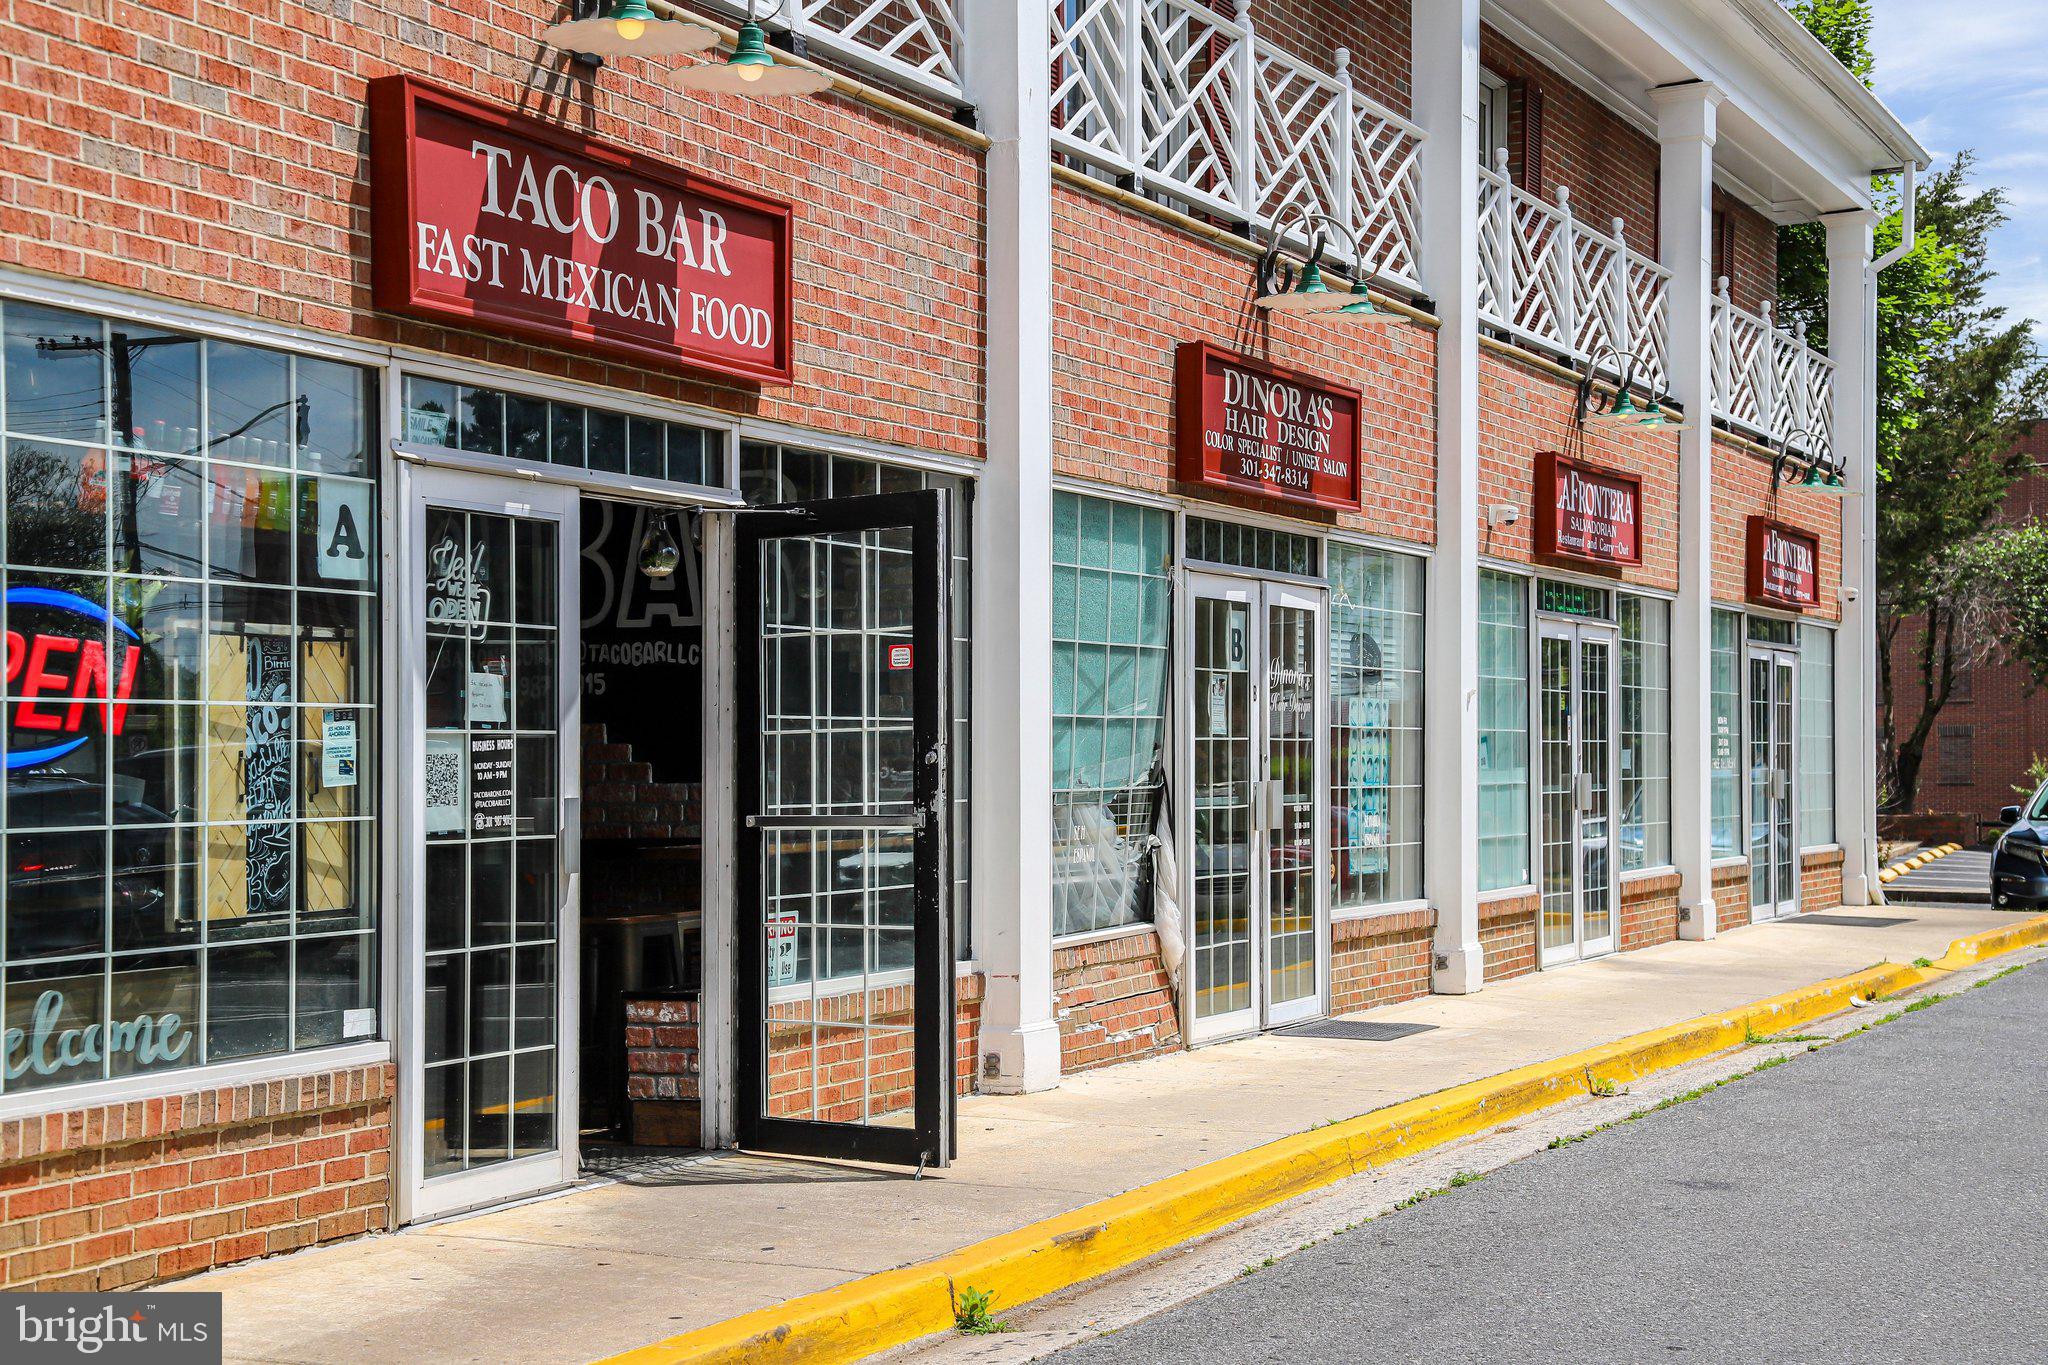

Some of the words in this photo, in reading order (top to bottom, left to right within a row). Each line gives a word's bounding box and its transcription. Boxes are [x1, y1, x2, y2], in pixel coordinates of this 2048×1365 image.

[472, 139, 619, 244] TACO
[634, 188, 731, 277] BAR
[417, 221, 508, 288] FAST
[520, 247, 680, 330] MEXICAN
[690, 292, 772, 349] FOOD
[1223, 368, 1333, 431] DINORA'S
[1205, 430, 1234, 452] COLOR
[1238, 437, 1282, 463] SPECIALIST
[1292, 451, 1320, 472] UNISEX
[1323, 458, 1347, 477] SALON
[1226, 408, 1268, 439] HAIR
[1277, 421, 1330, 454] DESIGN
[327, 504, 364, 559] A
[1557, 529, 1585, 548] Restaurant
[1587, 536, 1597, 549] and
[1600, 538, 1629, 555] Carry-Out
[1570, 516, 1617, 538] SALVADORIAN
[429, 597, 481, 629] OPEN
[1231, 628, 1243, 662] B
[472, 740, 495, 752] BUSINESS
[497, 738, 514, 750] HOURS
